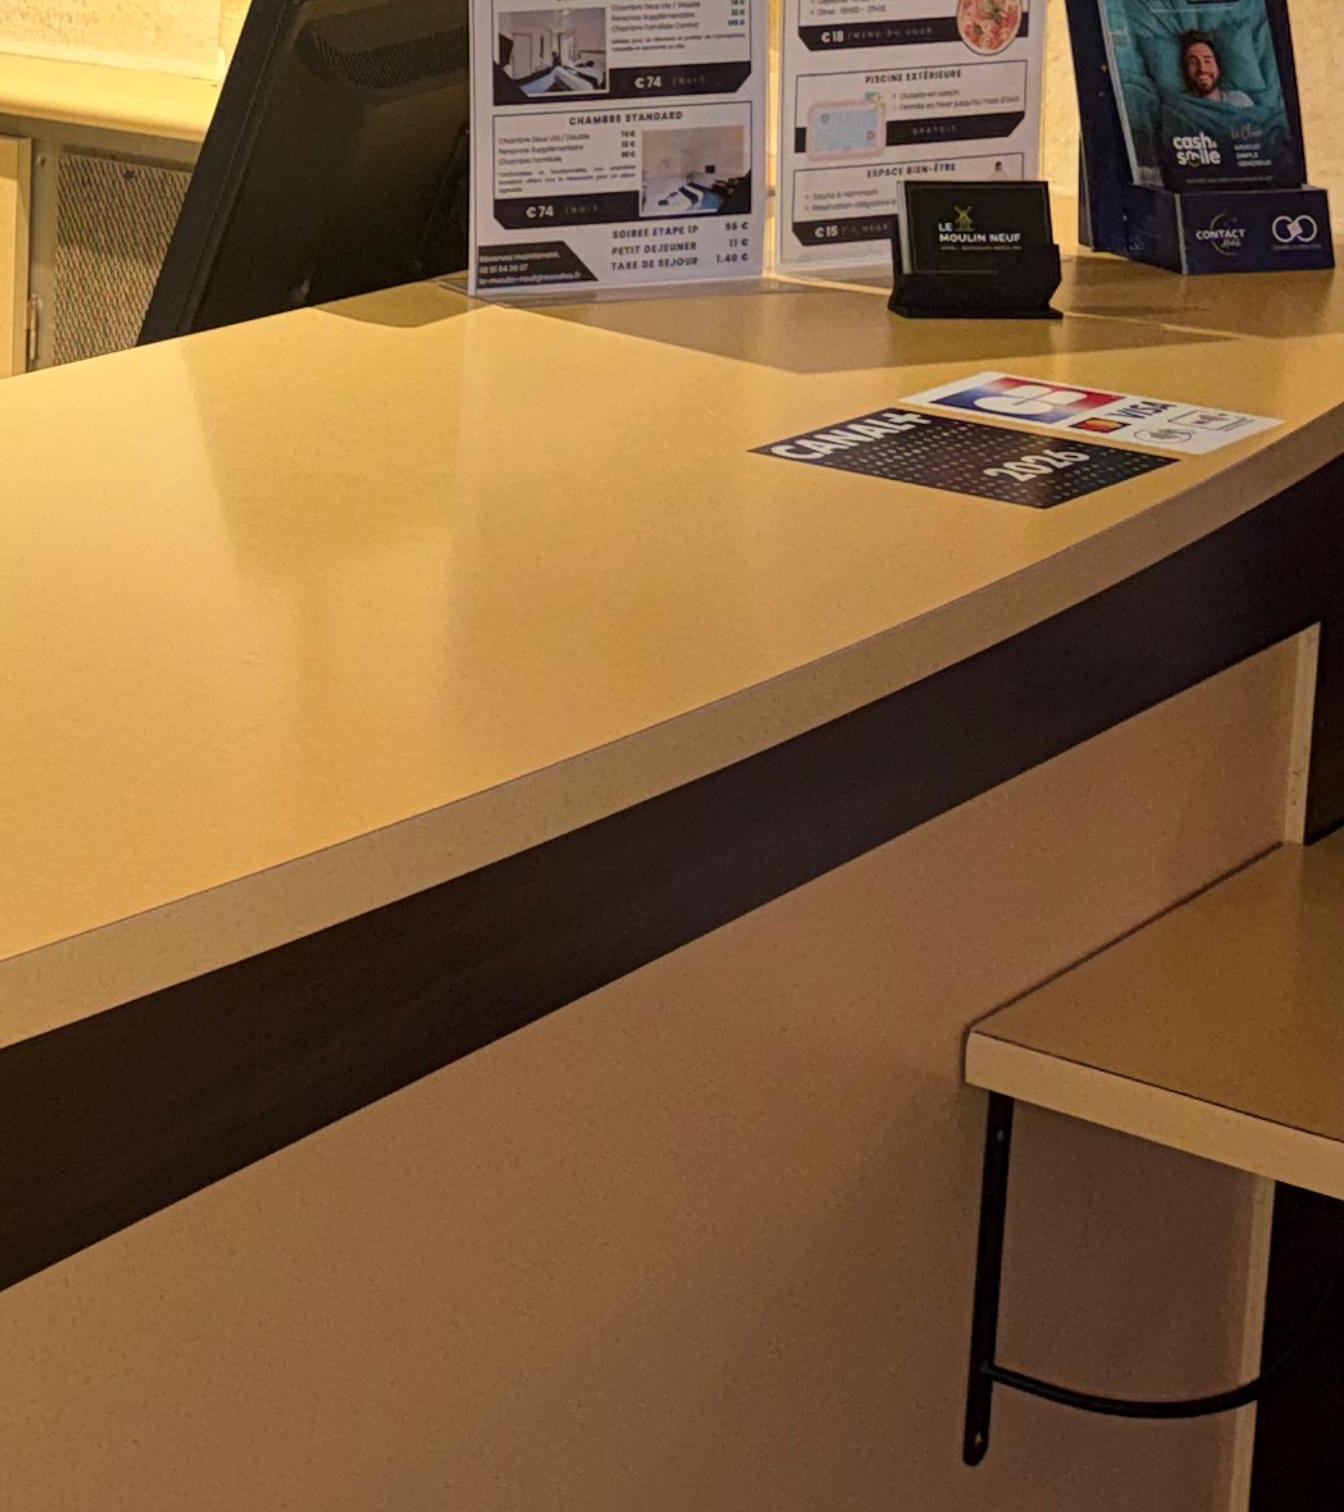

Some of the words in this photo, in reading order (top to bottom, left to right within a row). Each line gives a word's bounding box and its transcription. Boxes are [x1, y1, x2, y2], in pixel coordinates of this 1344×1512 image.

[865, 74, 903, 85] PISCINE
[906, 69, 962, 82] EXTÉRIEURE
[568, 114, 622, 126] CHAMBRE
[625, 110, 684, 123] STANDARD
[867, 167, 904, 179] ESPACE
[938, 222, 953, 233] LE
[1195, 228, 1247, 241] CONTACT
[938, 232, 987, 243] MOULIN
[989, 233, 1022, 243] NEUF
[611, 261, 638, 272] TAXE
[641, 259, 654, 270] DE
[1105, 400, 1179, 420] VISA
[770, 411, 932, 462] CANAL+
[984, 449, 1091, 483] 2026
